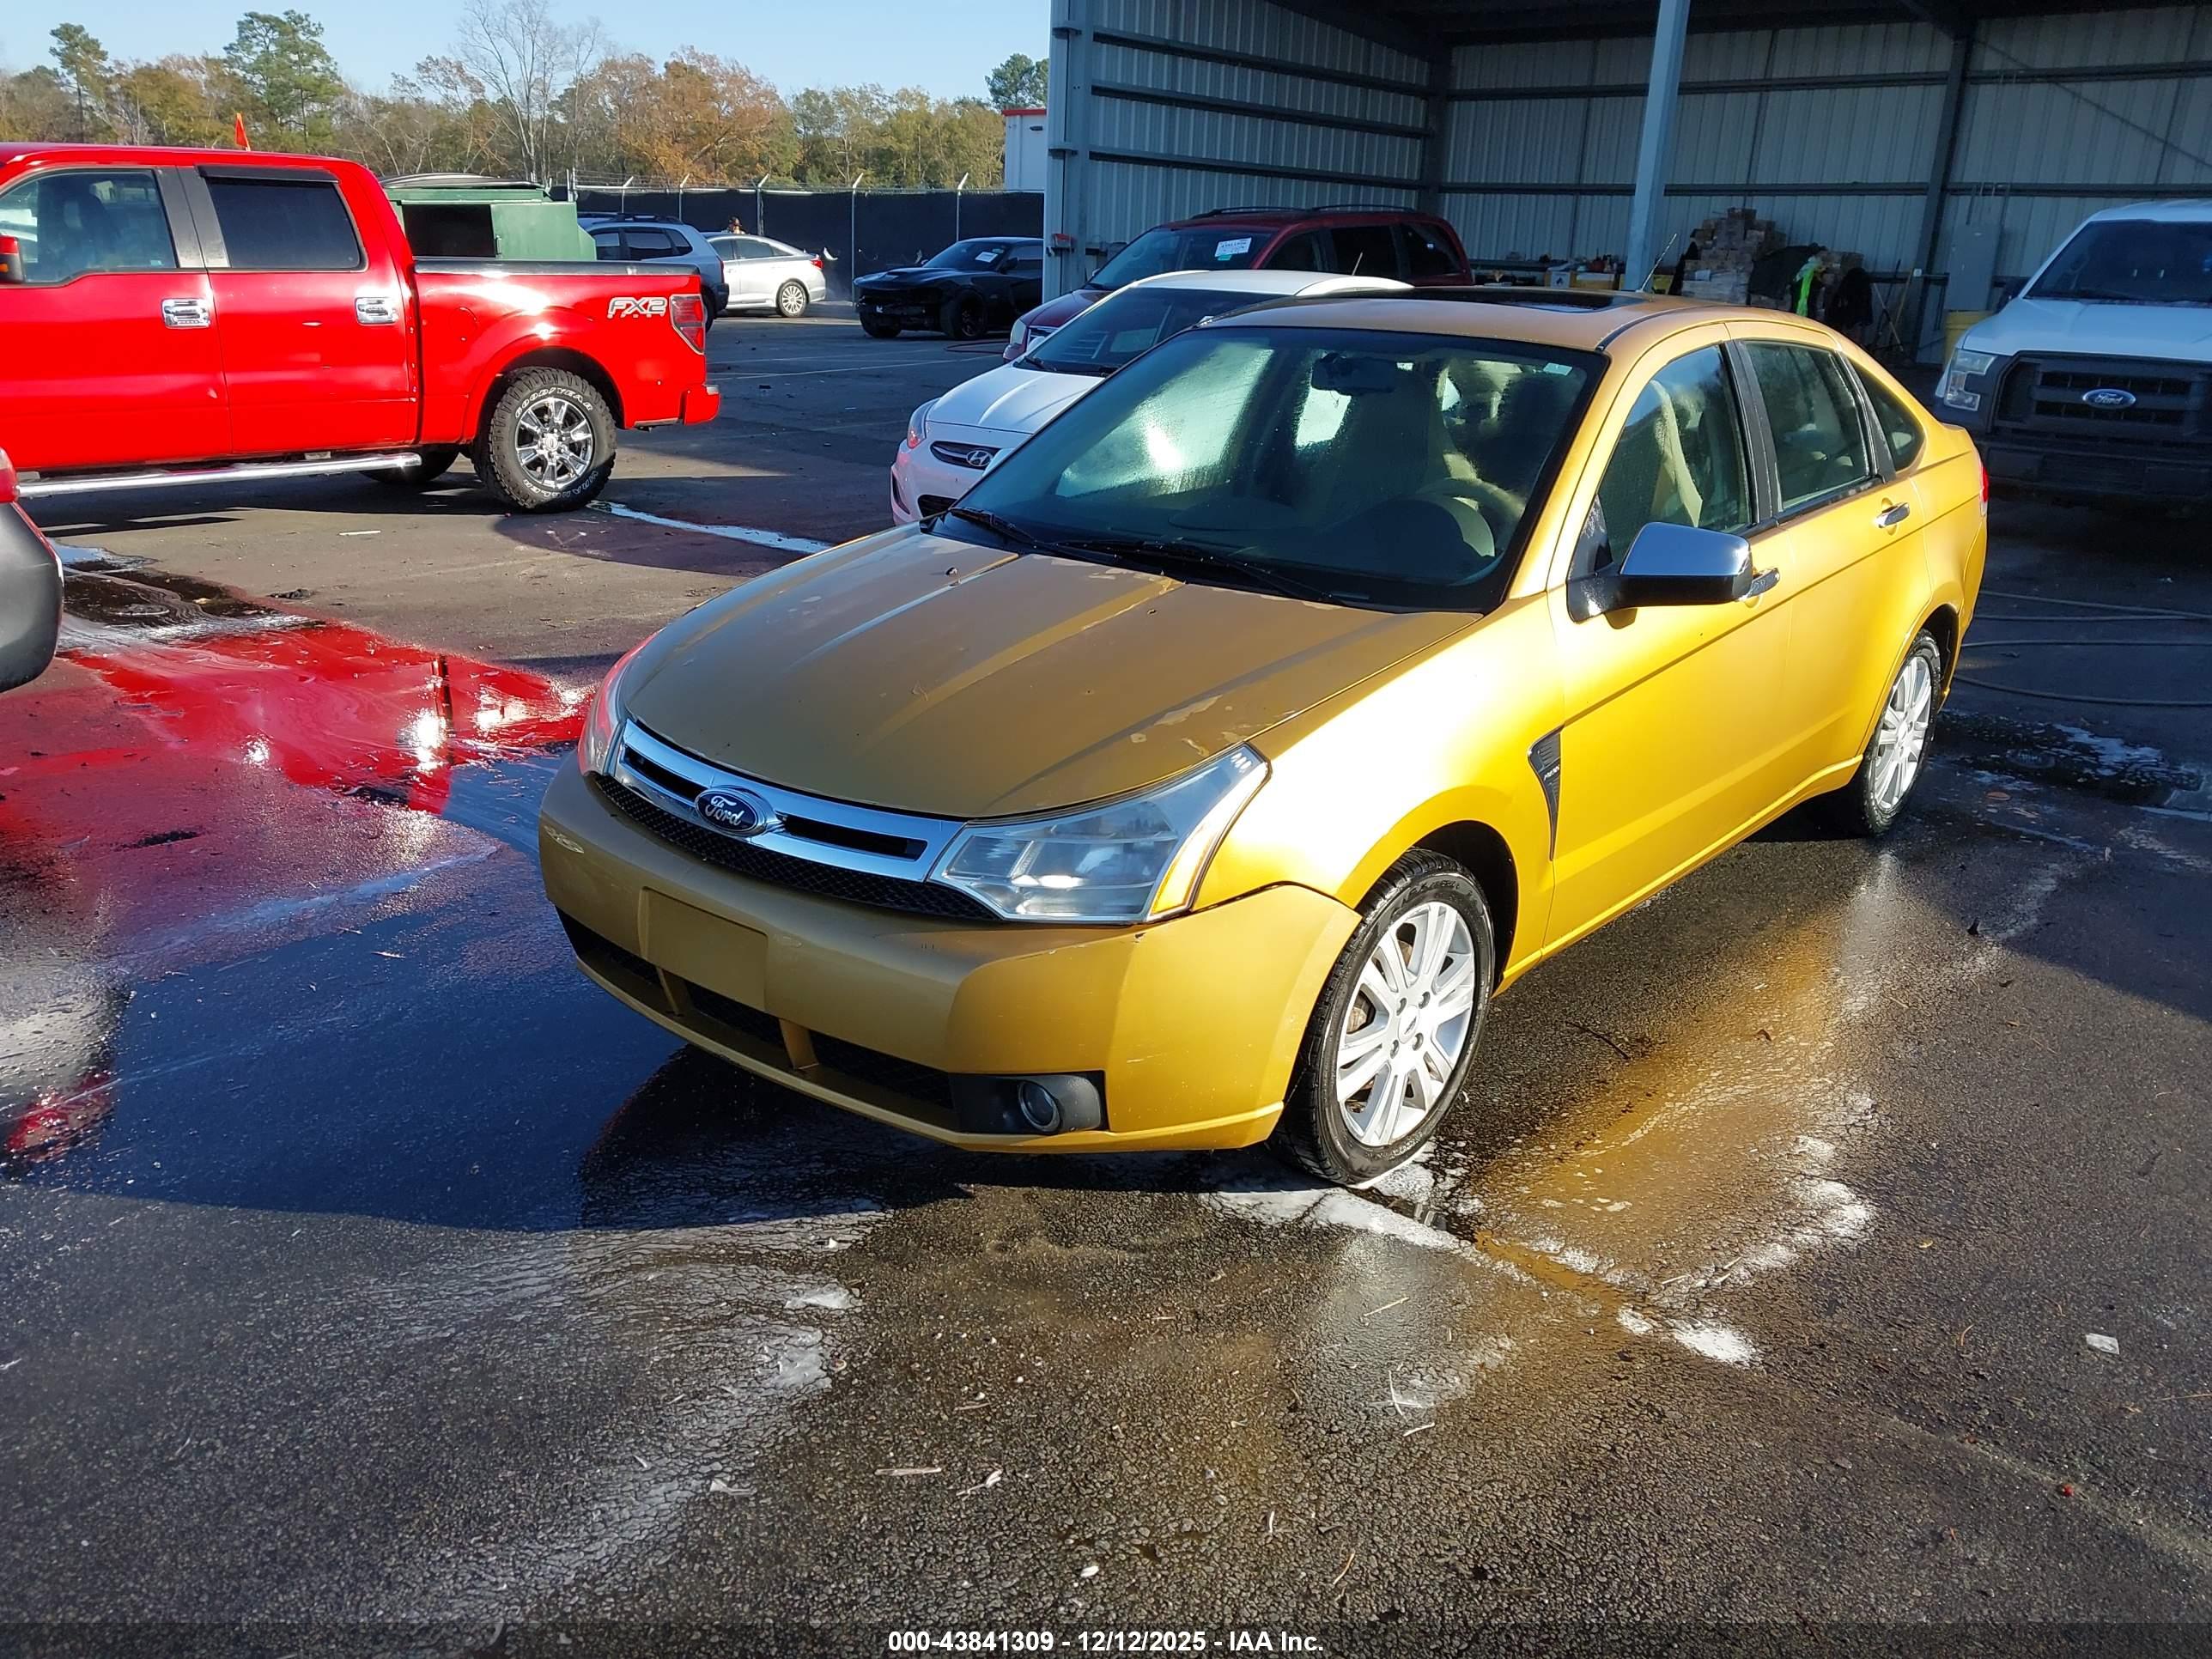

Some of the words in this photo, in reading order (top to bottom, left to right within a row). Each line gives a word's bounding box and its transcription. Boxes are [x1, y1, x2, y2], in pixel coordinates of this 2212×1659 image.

[607, 296, 667, 316] FX2
[2094, 392, 2124, 404] Ford
[704, 795, 745, 826] Ford
